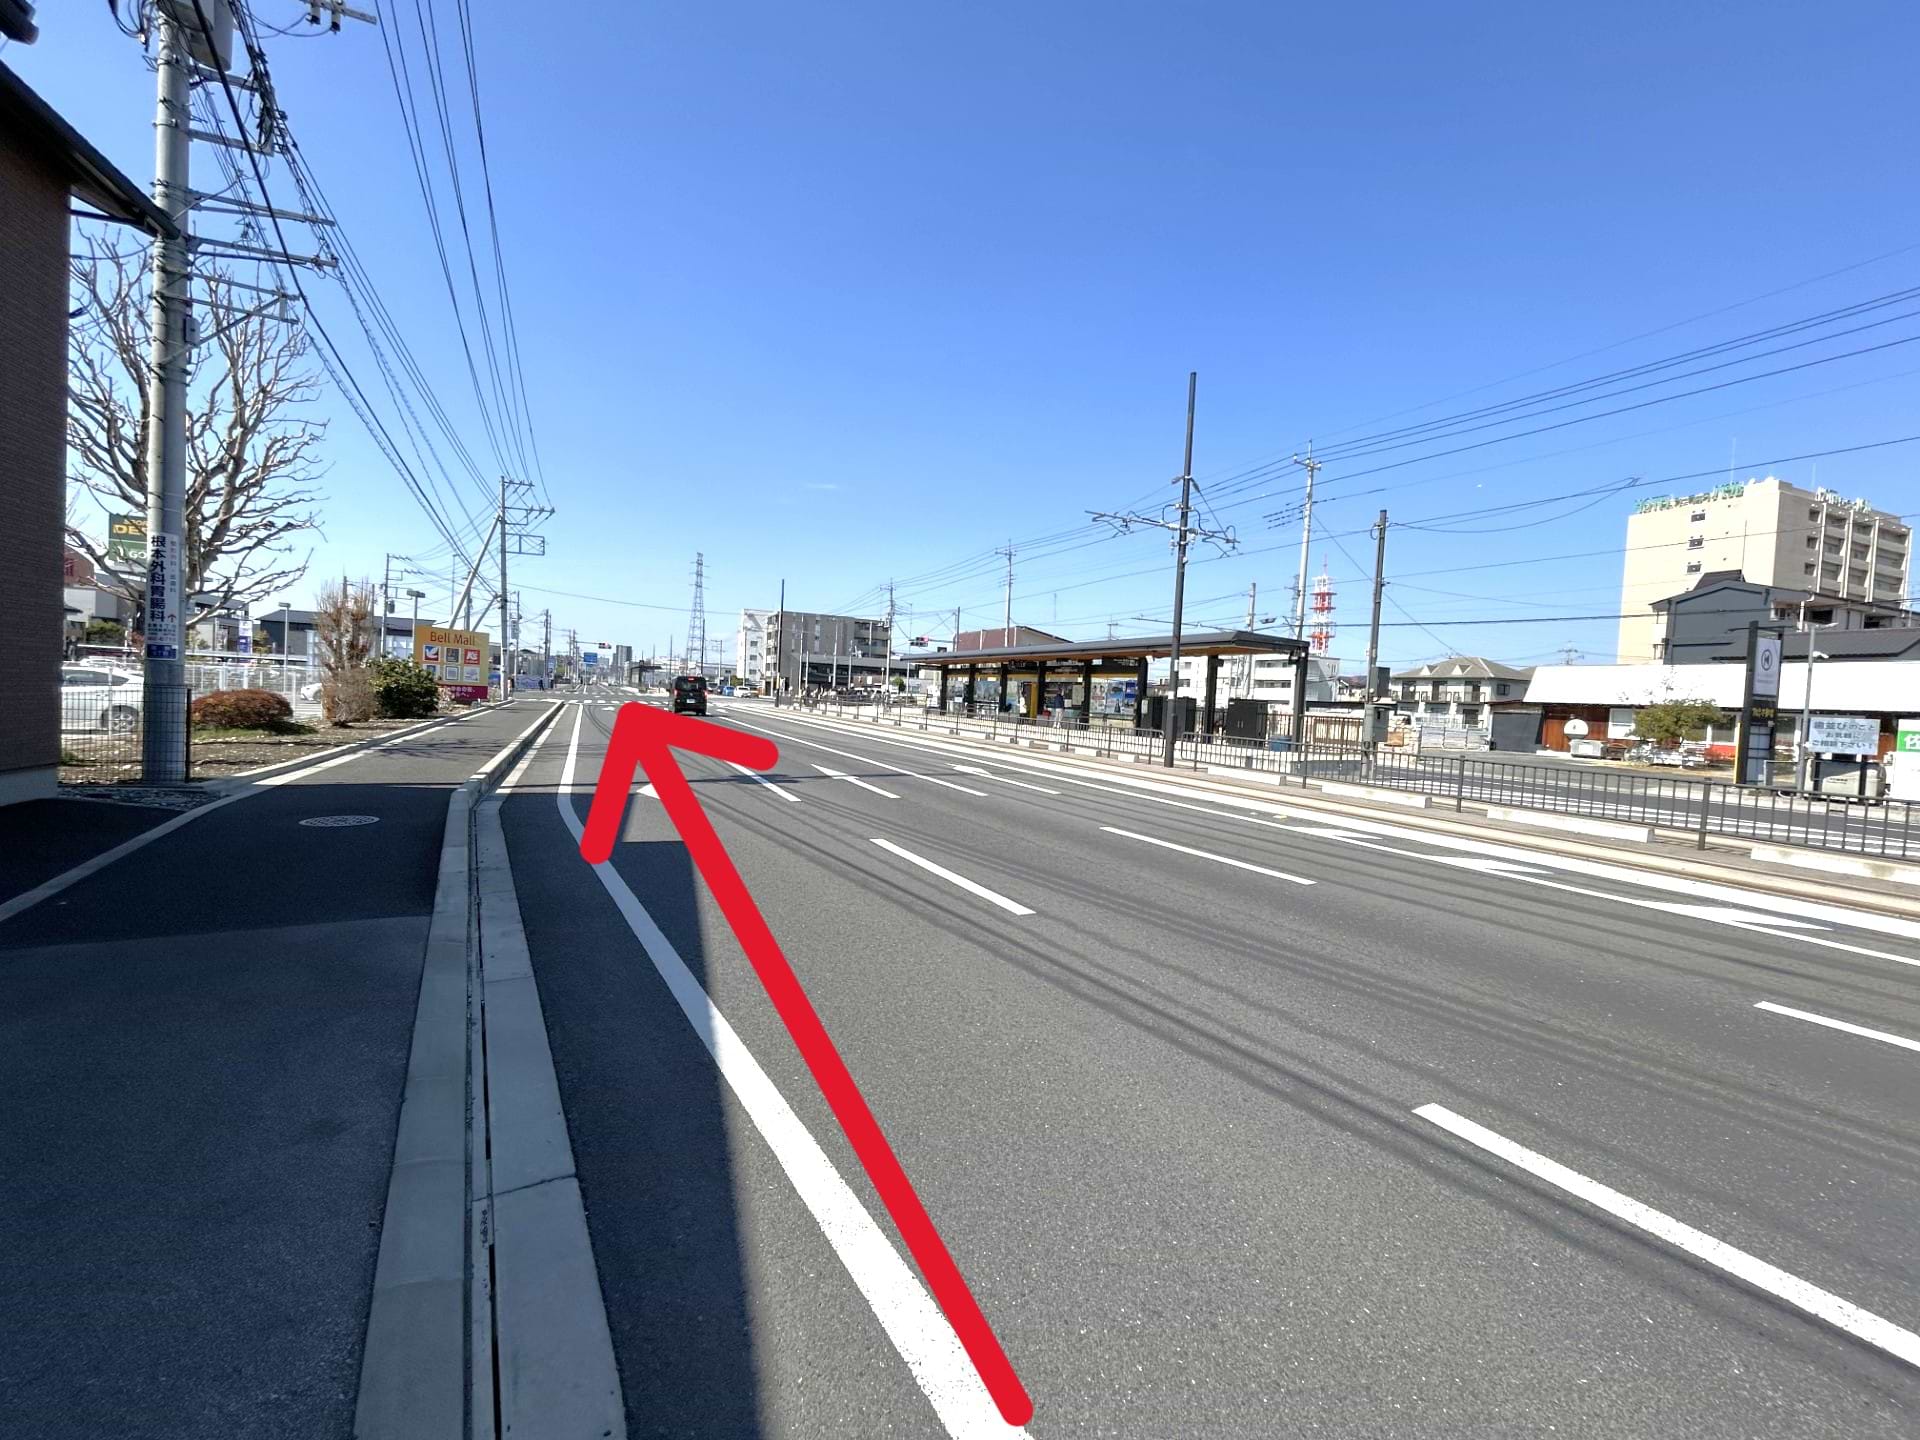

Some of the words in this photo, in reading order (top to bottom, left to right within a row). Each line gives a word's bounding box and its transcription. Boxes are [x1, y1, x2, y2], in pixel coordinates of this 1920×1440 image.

[149, 535, 167, 622] 根本外科胃腸科
[430, 631, 450, 644] Bell
[453, 633, 475, 646] Mall
